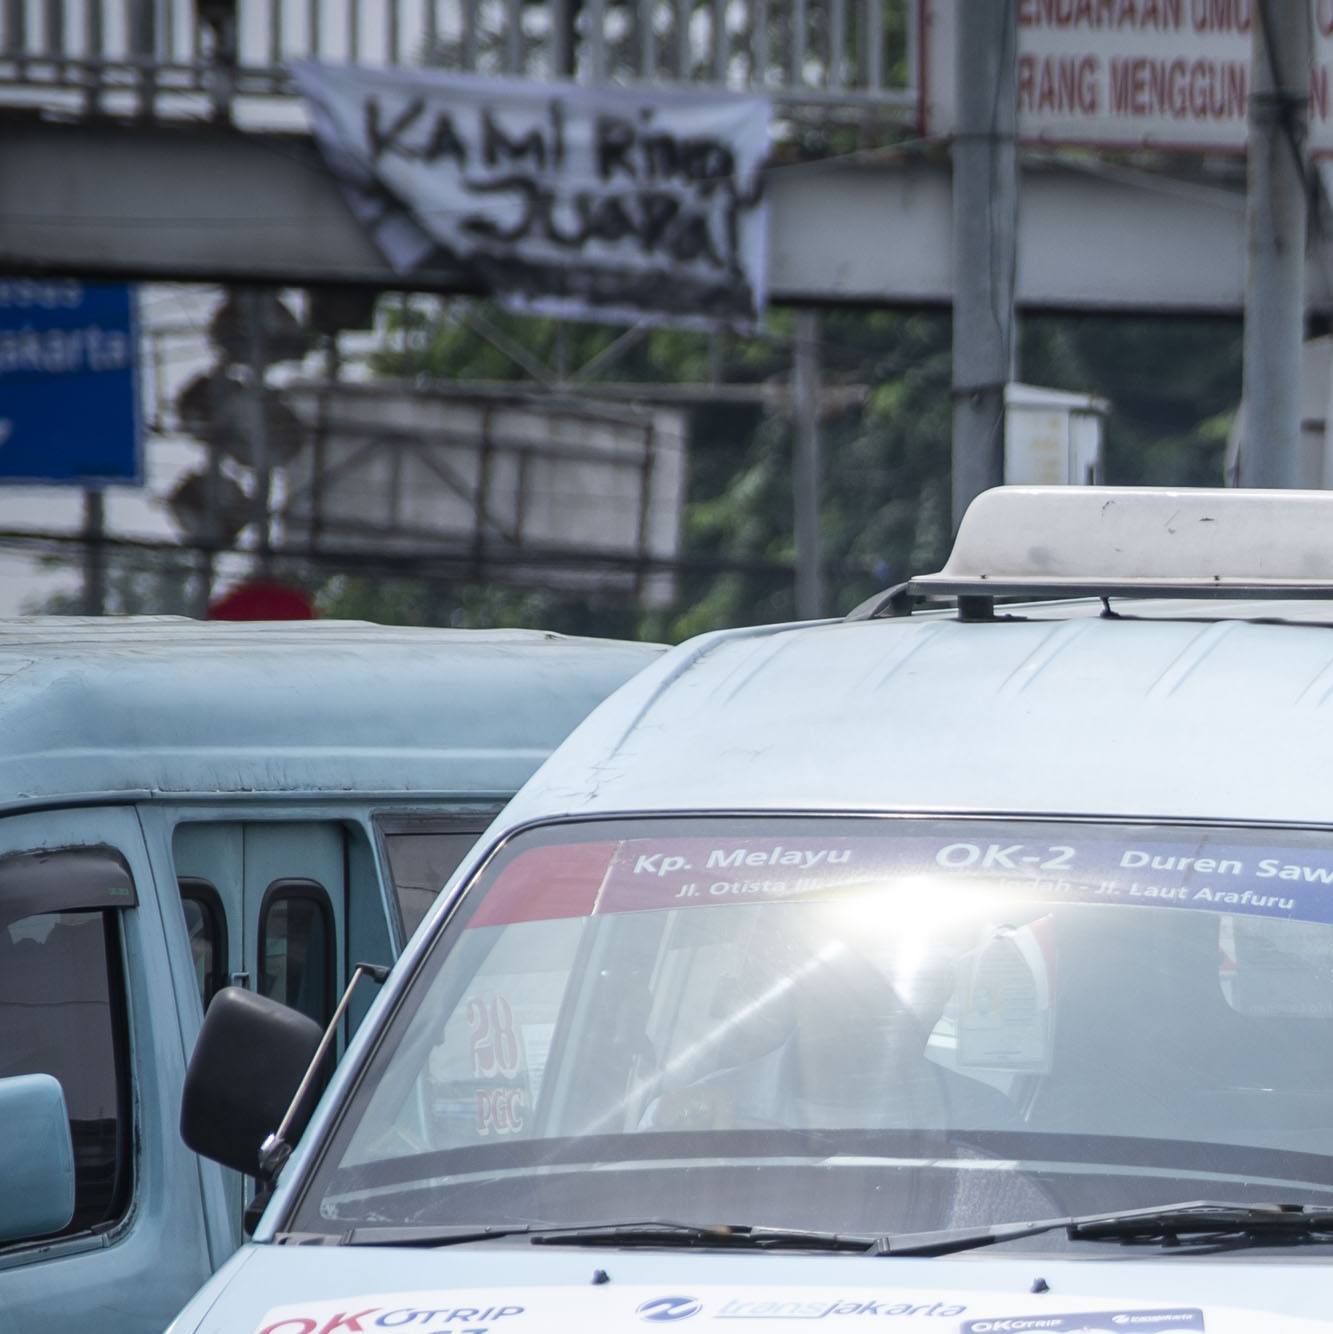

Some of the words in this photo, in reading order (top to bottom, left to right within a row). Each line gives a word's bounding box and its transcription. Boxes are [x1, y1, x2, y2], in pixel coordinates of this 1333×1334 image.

[1018, 54, 1098, 116] RANG
[633, 852, 692, 877] Kp.
[706, 845, 852, 869] Melayu
[934, 842, 1077, 870] OK-2
[1119, 850, 1242, 875] Duren
[709, 880, 787, 897] Otista
[1130, 882, 1188, 900] Laut
[1193, 886, 1296, 910] Arafuru
[712, 1298, 968, 1320] transjakarta
